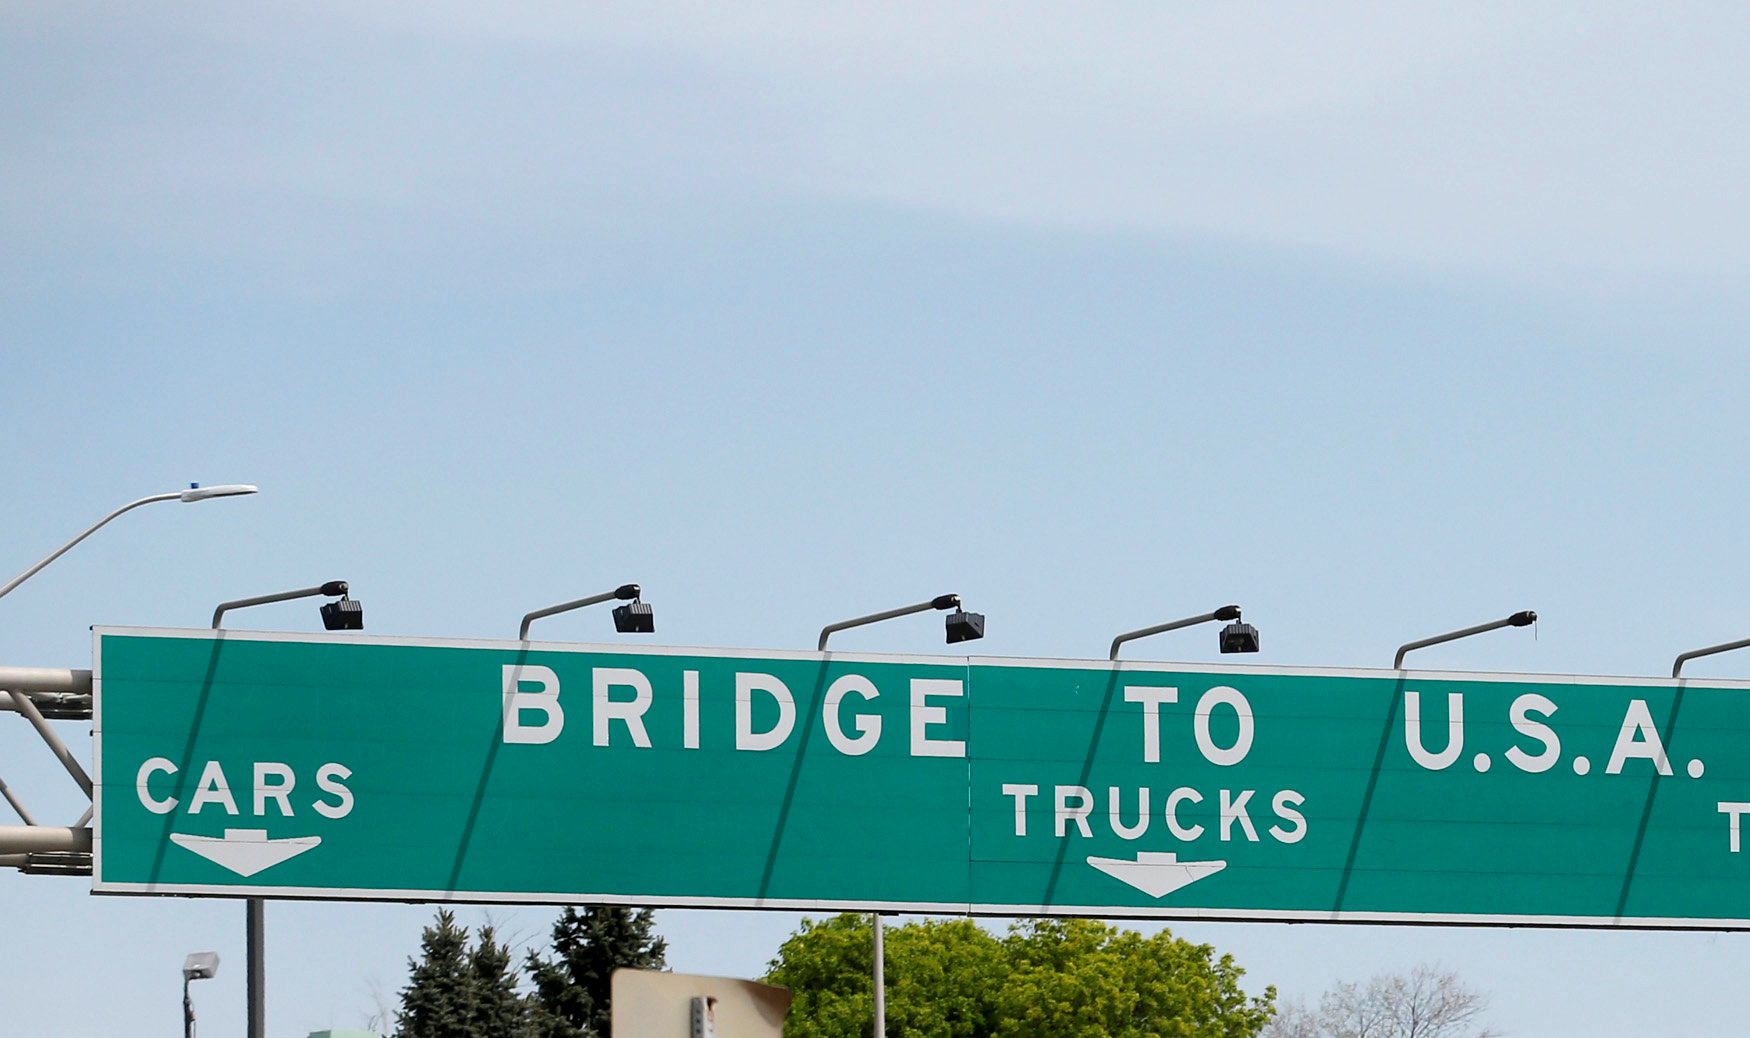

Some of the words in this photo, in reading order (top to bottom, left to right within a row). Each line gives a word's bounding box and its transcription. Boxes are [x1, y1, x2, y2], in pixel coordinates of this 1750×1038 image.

[502, 664, 966, 758] BRIDGE
[1124, 685, 1255, 766] TO
[1405, 691, 1705, 779] U.S.A.
[136, 757, 354, 819] CARS
[1002, 783, 1307, 844] TRUCKS
